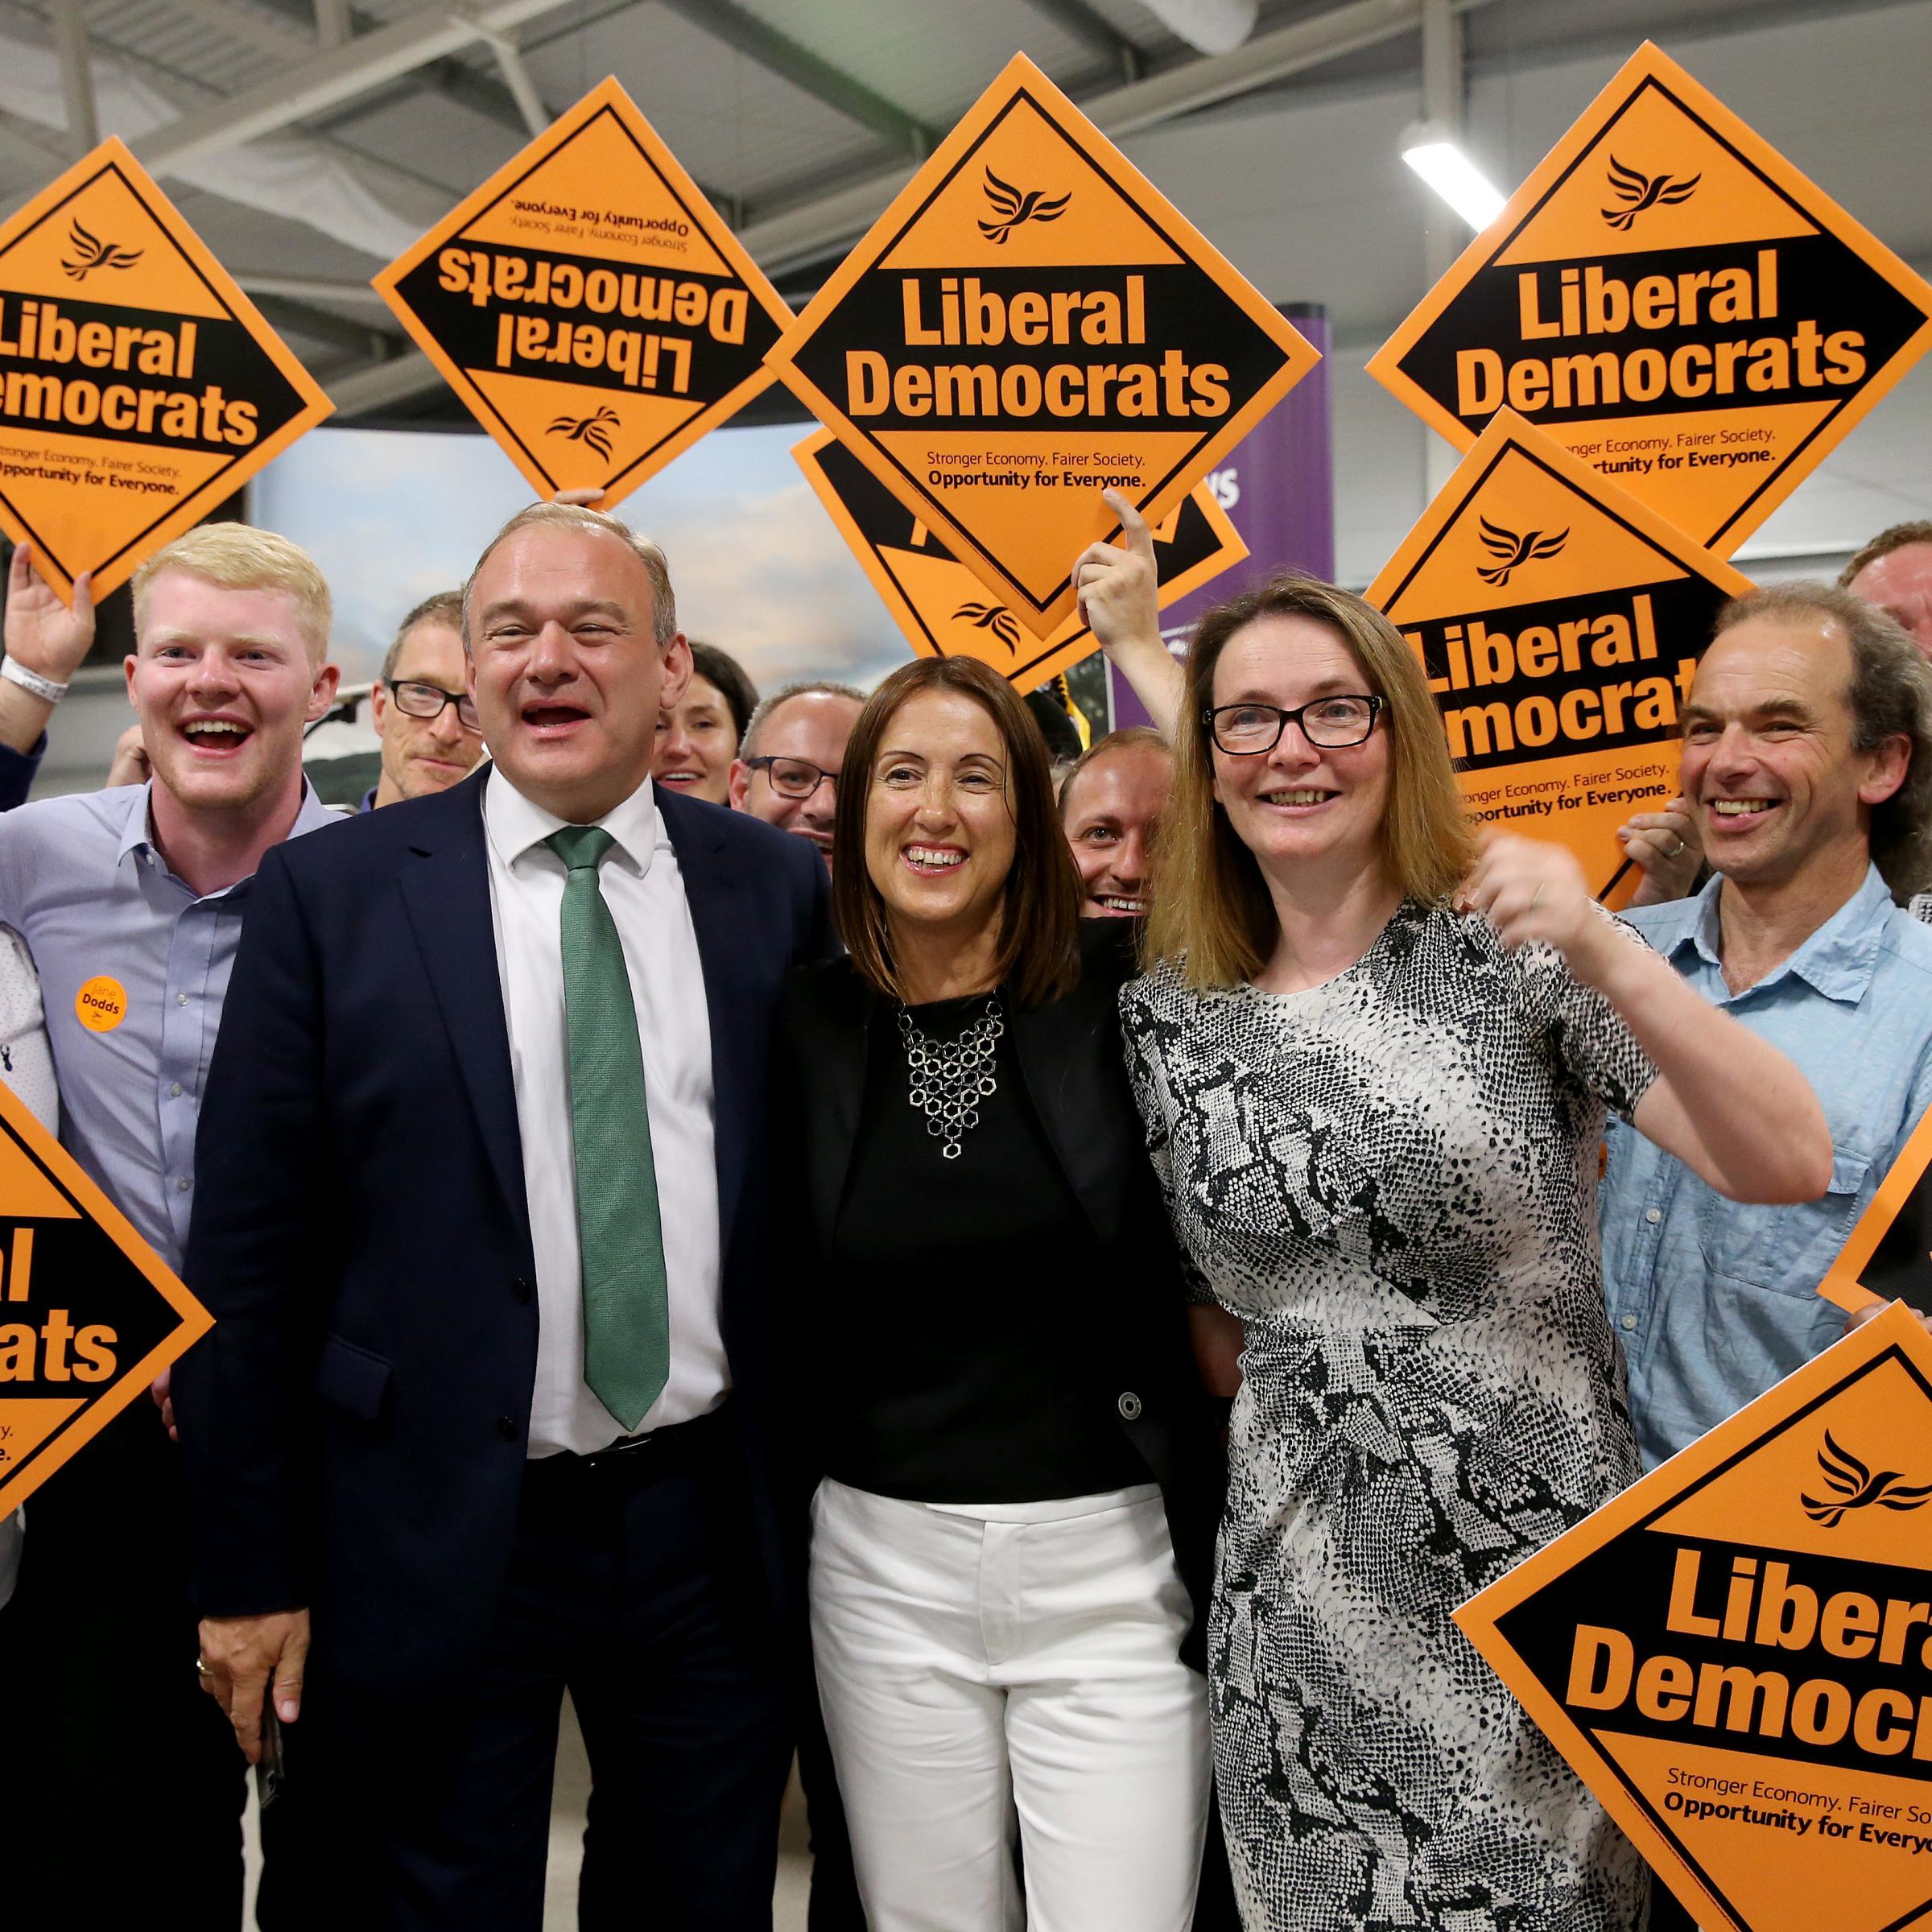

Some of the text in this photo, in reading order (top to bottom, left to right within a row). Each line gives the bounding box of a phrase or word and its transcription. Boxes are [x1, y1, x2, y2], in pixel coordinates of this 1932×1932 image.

[510, 216, 688, 253] Stronger Economy. Fairer Society.
[512, 200, 688, 237] Opportunity for Everyone.
[439, 248, 749, 345] Democrats
[902, 275, 1146, 346] Liberal
[1519, 249, 1777, 341] Liberal
[497, 313, 692, 394] Liberal
[1456, 320, 1866, 416] Democrats
[846, 350, 1230, 418] Democrats
[0, 371, 258, 446] mocrats
[1606, 438, 1673, 452] Economy.
[1678, 433, 1716, 448] Fairer
[1721, 429, 1776, 444] Society.
[1658, 454, 1683, 469] for
[1688, 449, 1776, 468] Everyone.
[0, 460, 180, 495] pportunity for Everyone.
[43, 449, 99, 469] Economy.
[101, 456, 133, 471] Fairer
[136, 461, 181, 478] Society.
[927, 452, 1146, 469] Stronger Economy. Fairer Society.
[928, 470, 1030, 489] Opportunity
[1034, 471, 1059, 486] for
[1063, 472, 1146, 490] Everyone.
[1506, 780, 1571, 798] Economy.
[1574, 772, 1612, 787] Fairer
[1616, 764, 1670, 781] Society.
[1558, 795, 1583, 810] for
[1587, 783, 1672, 805] Everyone.
[82, 993, 120, 1014] Dodds
[1667, 1767, 1748, 1796] Stronger
[1753, 1781, 1842, 1812] Economy.
[1848, 1796, 1902, 1819] Fairer
[1664, 1792, 1812, 1836] Opportunity
[1818, 1815, 1854, 1839] for
